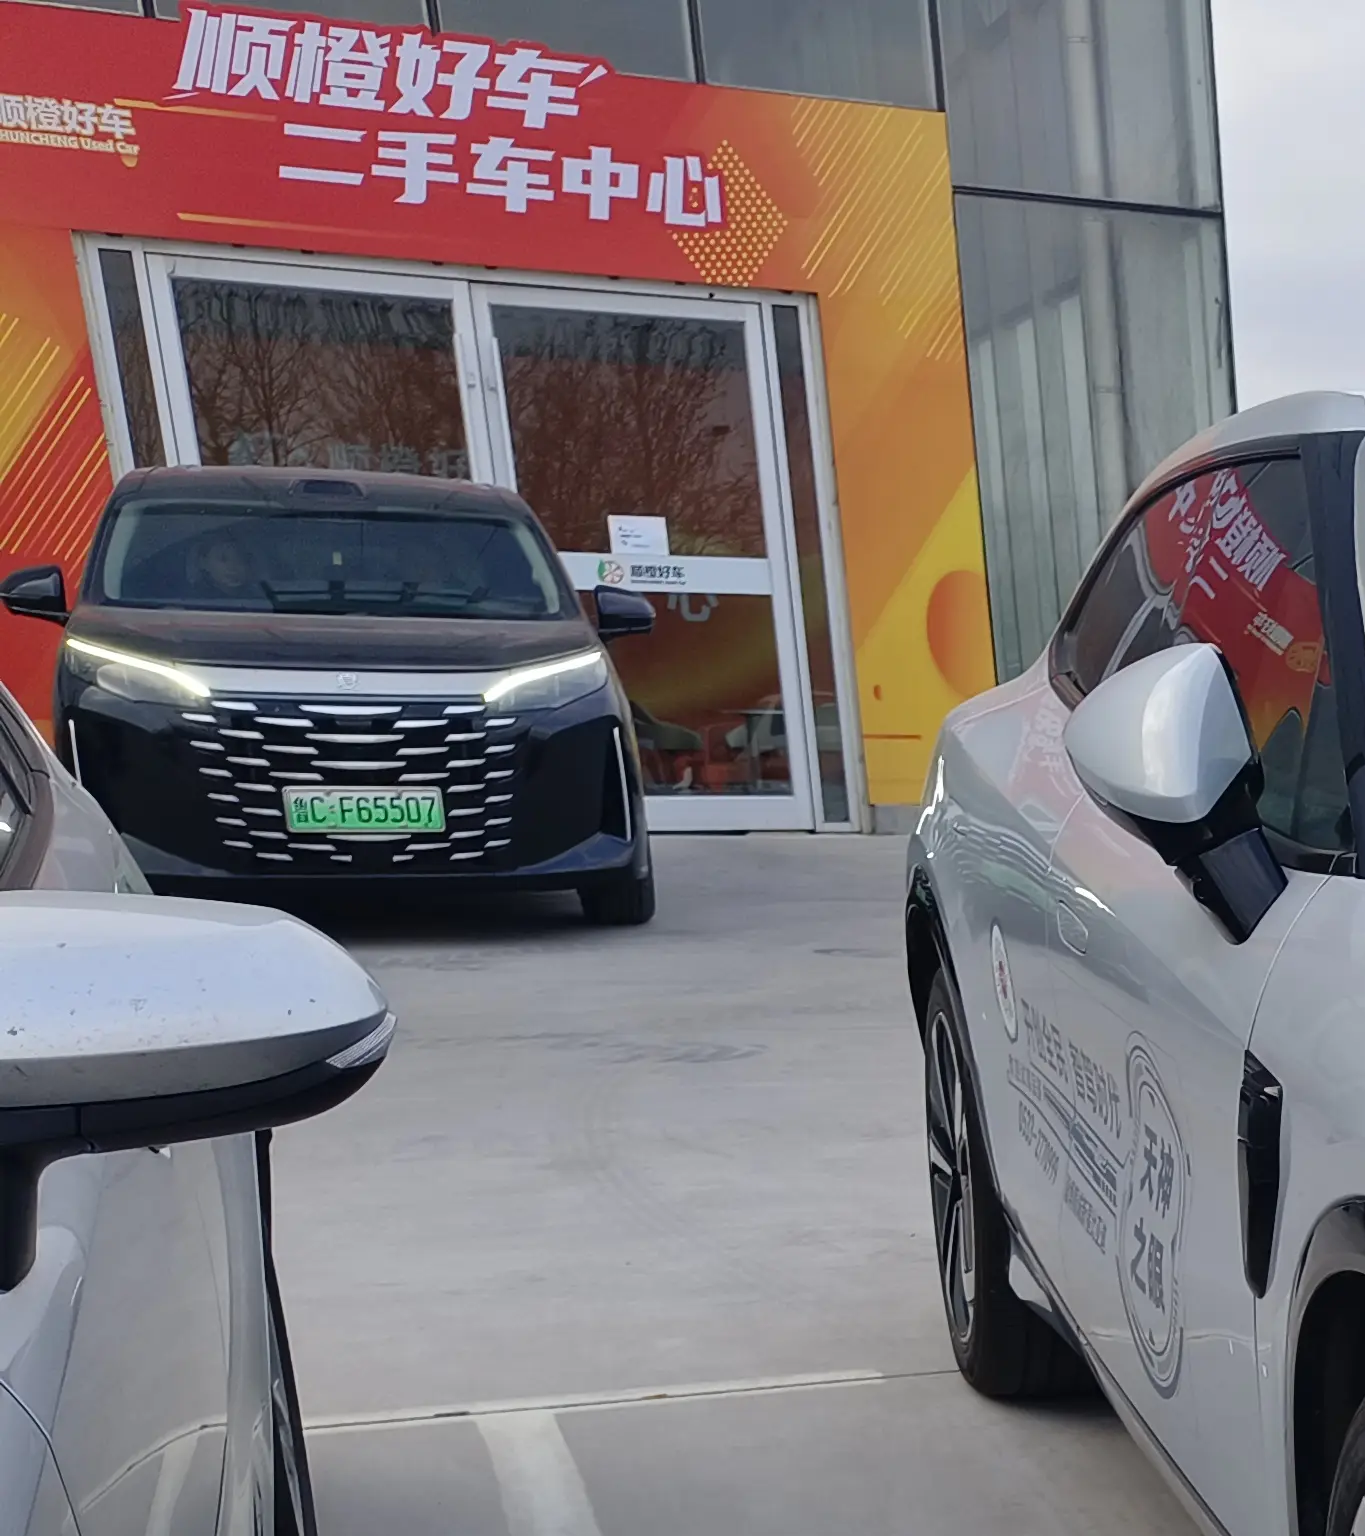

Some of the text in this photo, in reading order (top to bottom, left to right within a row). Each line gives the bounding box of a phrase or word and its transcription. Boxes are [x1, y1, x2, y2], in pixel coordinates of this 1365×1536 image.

[172, 8, 594, 129] 顺橙好车
[80, 138, 115, 152] Used
[116, 141, 139, 154] Car
[279, 122, 721, 227] 二手车中心
[1139, 1123, 1175, 1220] 天神
[1130, 1216, 1166, 1316] 之眼
